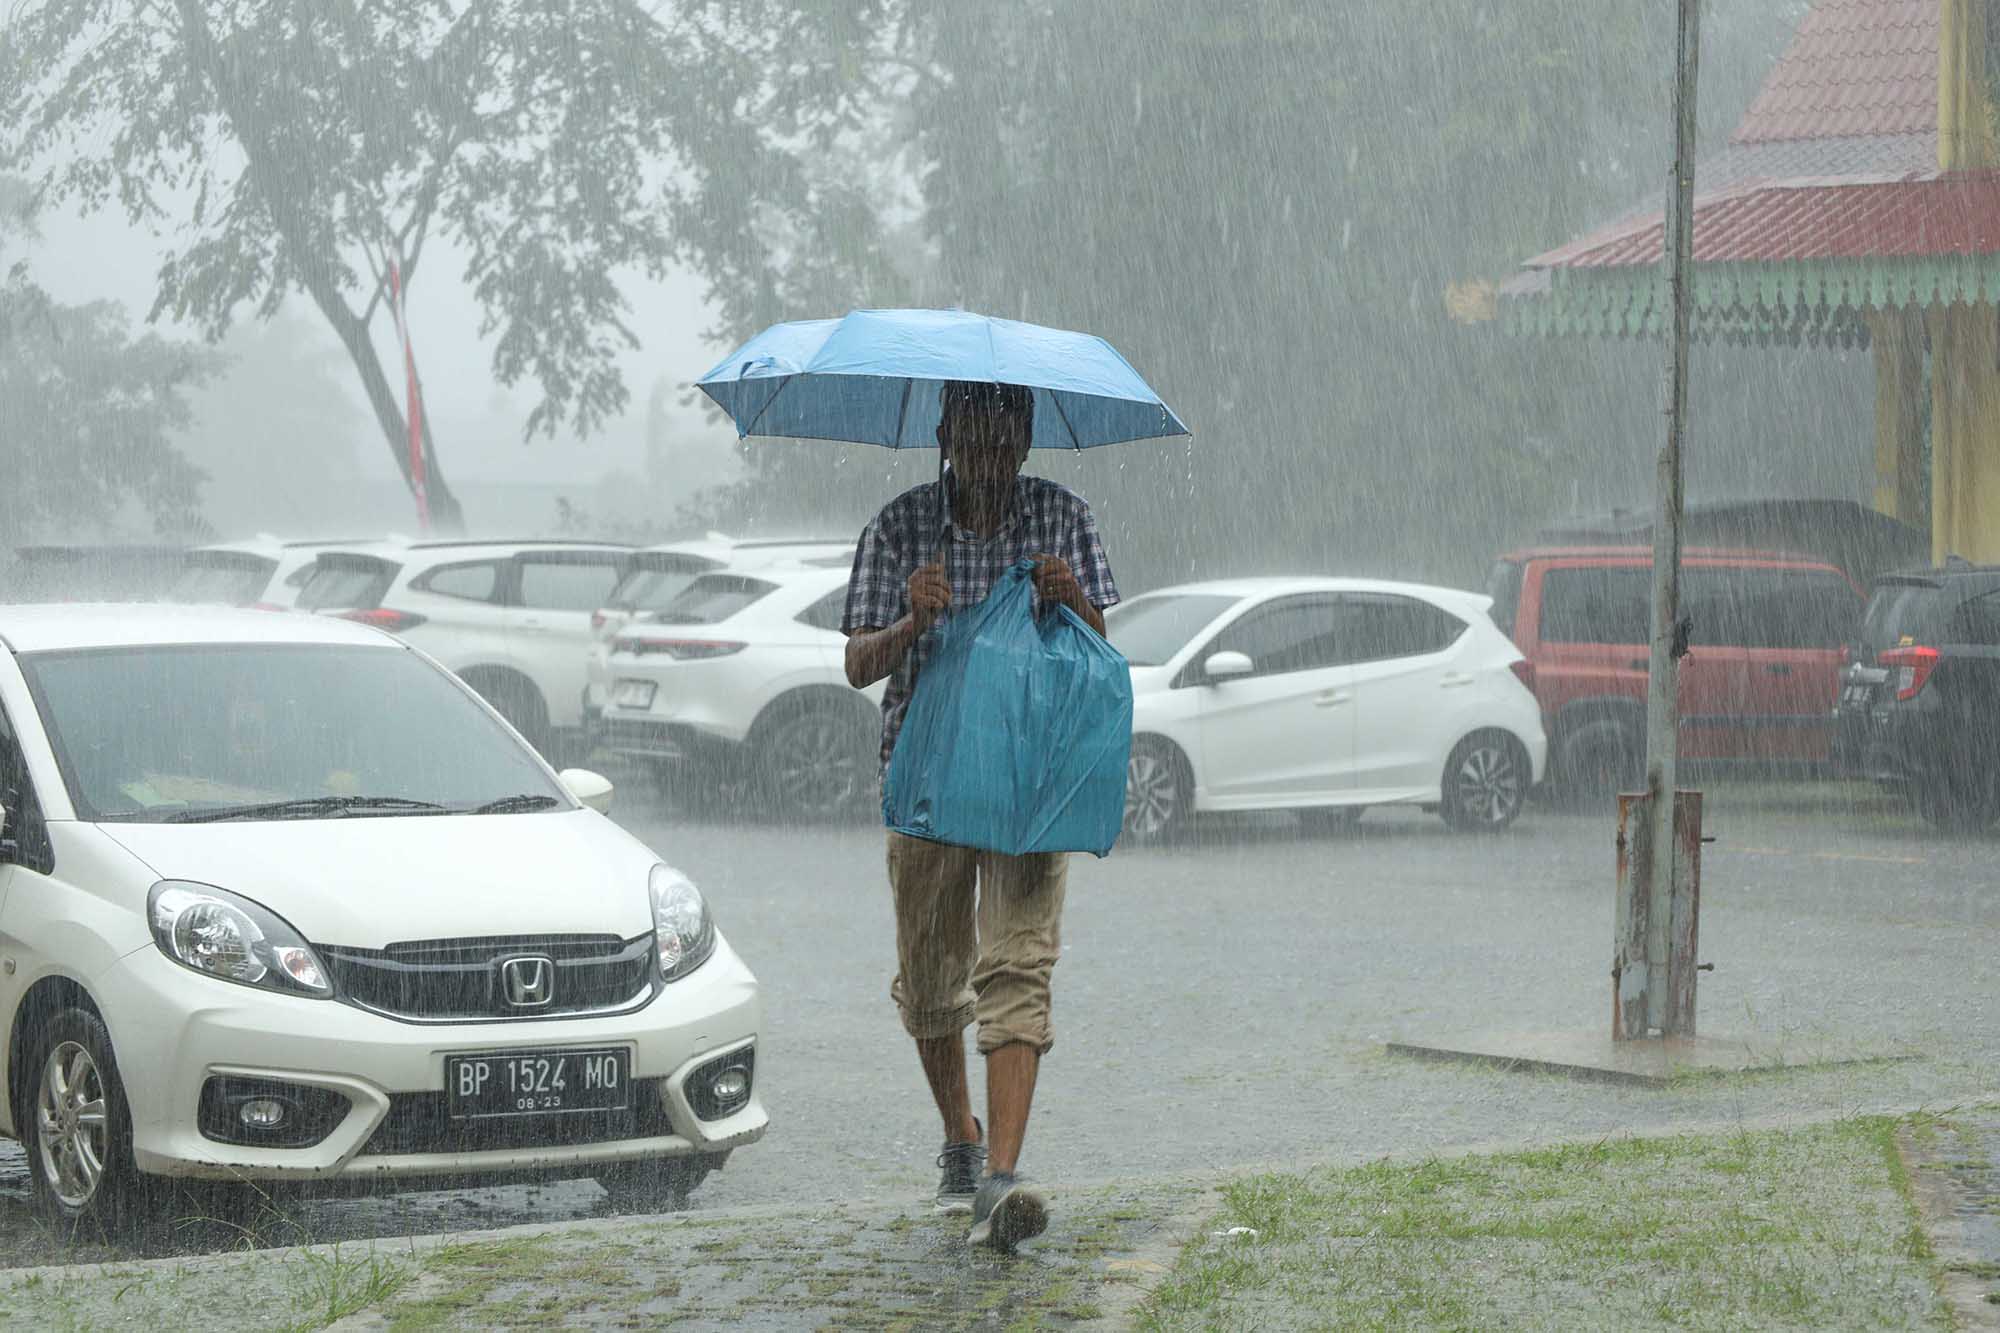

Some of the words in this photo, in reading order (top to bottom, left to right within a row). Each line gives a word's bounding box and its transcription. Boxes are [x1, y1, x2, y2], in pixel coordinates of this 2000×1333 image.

[459, 1062, 490, 1097] BP
[507, 1057, 566, 1093] 1524
[585, 1056, 618, 1089] MQ
